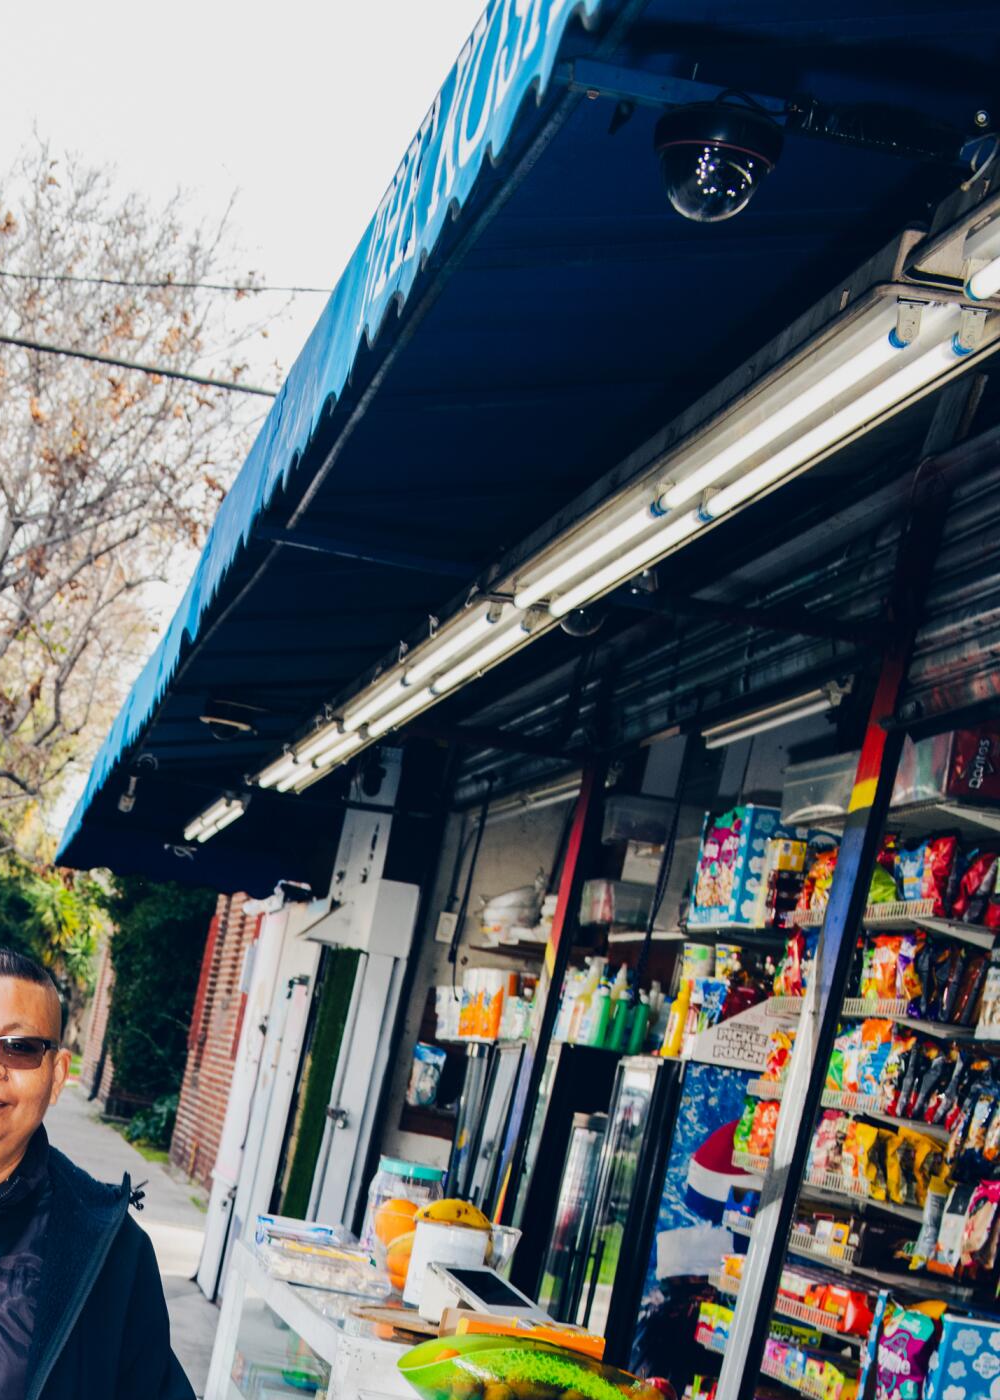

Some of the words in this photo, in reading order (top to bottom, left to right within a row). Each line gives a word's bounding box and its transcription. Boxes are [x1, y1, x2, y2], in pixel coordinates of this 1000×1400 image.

[968, 739, 991, 789] Doritos
[716, 1027, 769, 1047] PICKLE
[712, 1044, 766, 1065] POUCH
